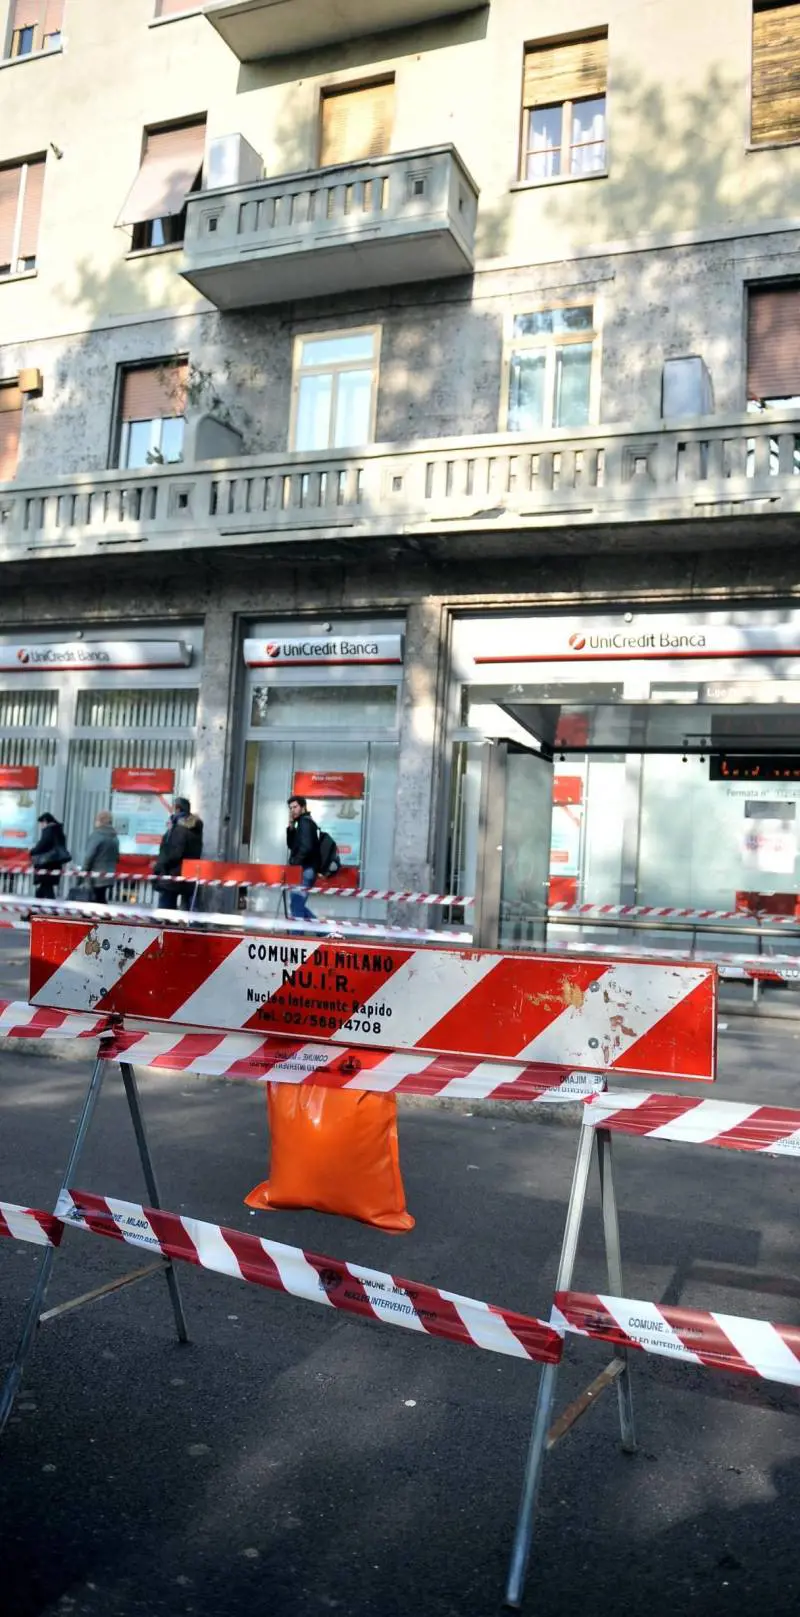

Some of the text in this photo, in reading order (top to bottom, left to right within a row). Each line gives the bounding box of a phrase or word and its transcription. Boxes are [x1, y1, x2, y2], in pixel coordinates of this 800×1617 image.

[590, 632, 706, 648] UniCredit Banca
[30, 649, 110, 663] UniCredit Banca
[283, 641, 379, 657] UniCredit Banca
[248, 943, 393, 973] COMUNE DI MILANO
[247, 988, 285, 1005] Nucleo
[352, 1000, 393, 1019] Rapido
[126, 1216, 149, 1230] MILANO
[356, 1278, 418, 1300] COMUNE MILANO
[371, 1297, 412, 1315] INTERVENTO
[628, 1317, 663, 1332] COMUNE
